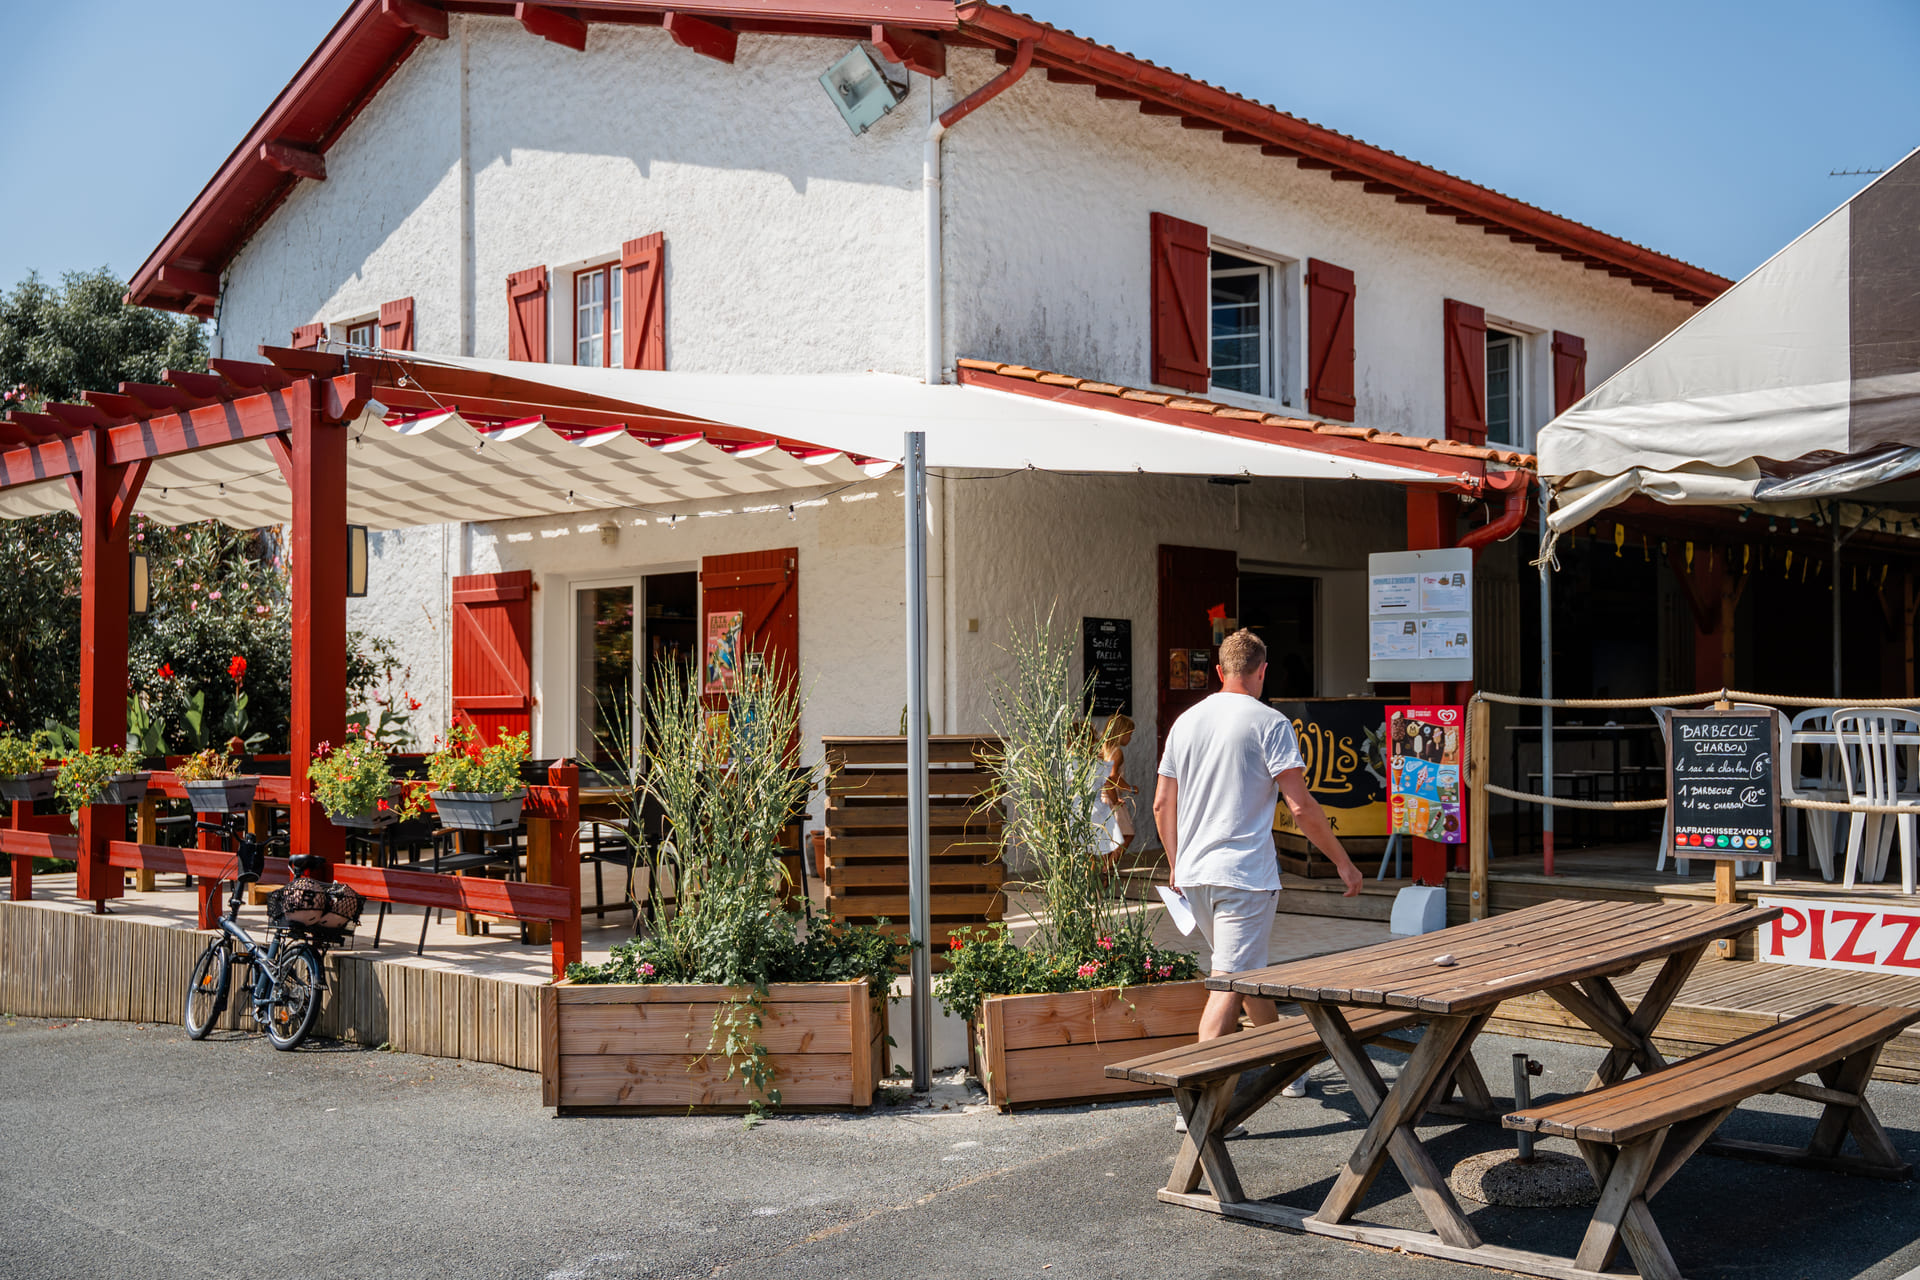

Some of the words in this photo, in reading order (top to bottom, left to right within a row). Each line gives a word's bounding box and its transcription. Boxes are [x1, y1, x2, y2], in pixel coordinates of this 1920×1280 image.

[1096, 650, 1122, 660] PAELLA
[1680, 724, 1758, 738] BARBECUE
[1694, 742, 1748, 753] CHARBON
[1718, 760, 1749, 773] charbon
[1690, 786, 1735, 795] BARBECUE
[1697, 802, 1711, 810] SAC
[1713, 801, 1745, 810] CHARBON
